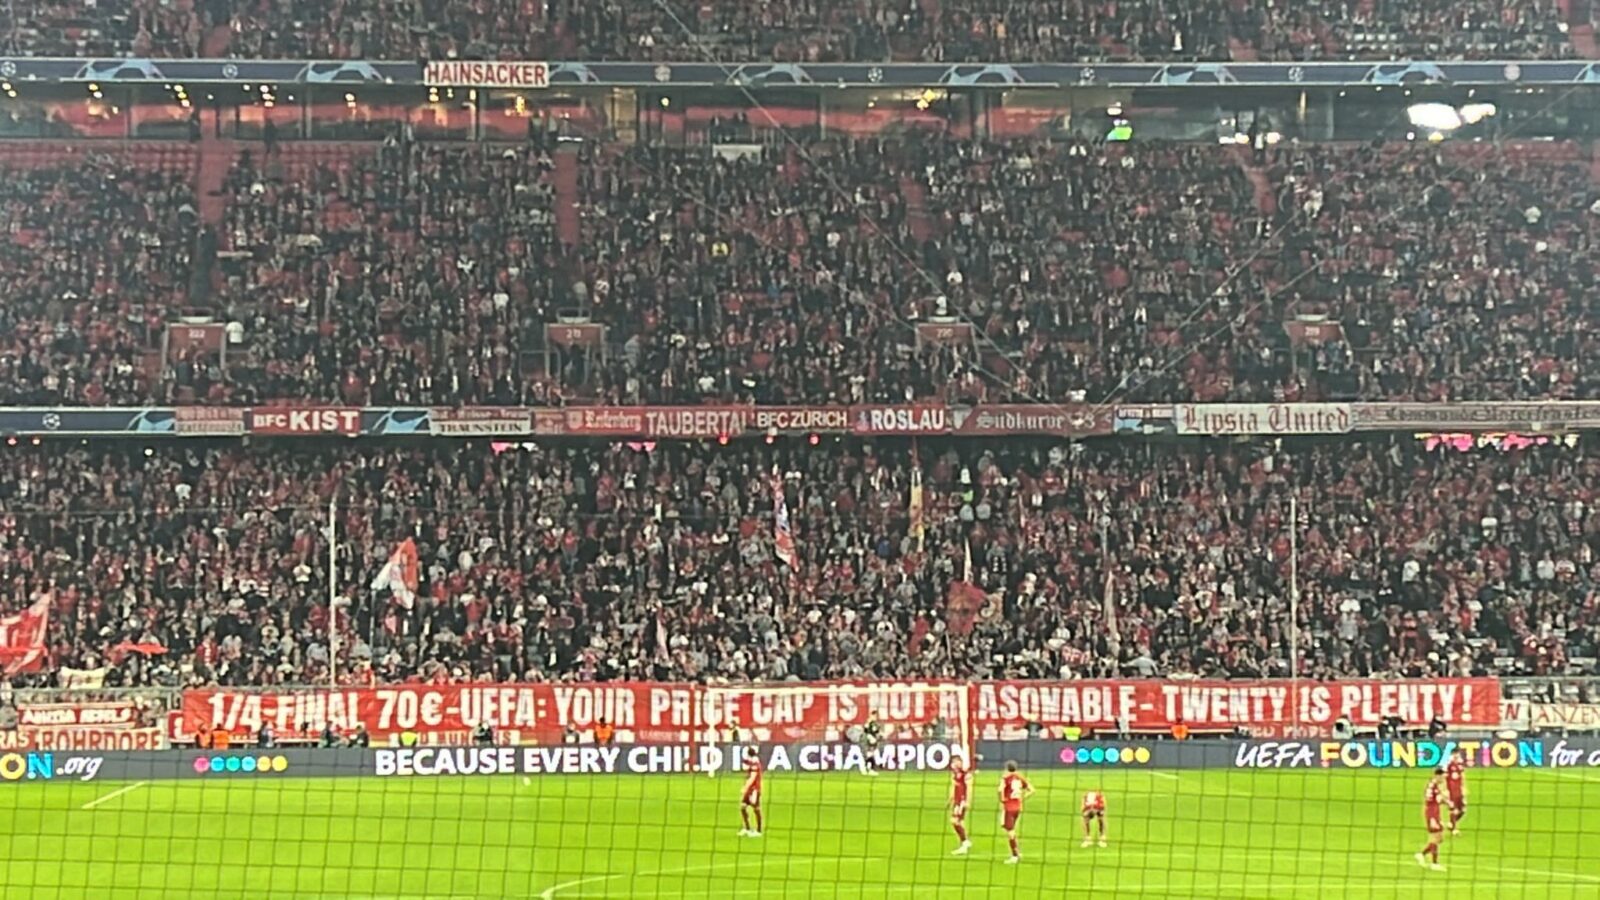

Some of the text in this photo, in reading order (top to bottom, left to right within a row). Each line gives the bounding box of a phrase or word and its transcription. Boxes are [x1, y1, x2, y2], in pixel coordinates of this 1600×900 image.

[427, 63, 546, 85] HAINSACKER
[253, 414, 288, 428] BFC
[289, 410, 359, 431] KIST
[440, 423, 522, 433] TRAUNSTEIN
[757, 411, 789, 428] BFC
[1265, 405, 1349, 432] United
[208, 692, 366, 733] 1/4-FINAL
[553, 687, 636, 727] YOUR
[650, 688, 740, 727] PRICE
[752, 688, 815, 726] CAP
[828, 684, 859, 722] IS
[867, 682, 929, 721] NOT
[1162, 684, 1287, 723] TWENTY
[1300, 686, 1332, 722] IS
[1340, 684, 1473, 723] PLENTY!
[42, 729, 161, 751] ROHRDORF
[375, 748, 516, 776] BECAUSE
[523, 748, 621, 774] EVERY
[767, 745, 792, 772] A
[1234, 740, 1315, 768] UEFA
[1549, 739, 1584, 769] for
